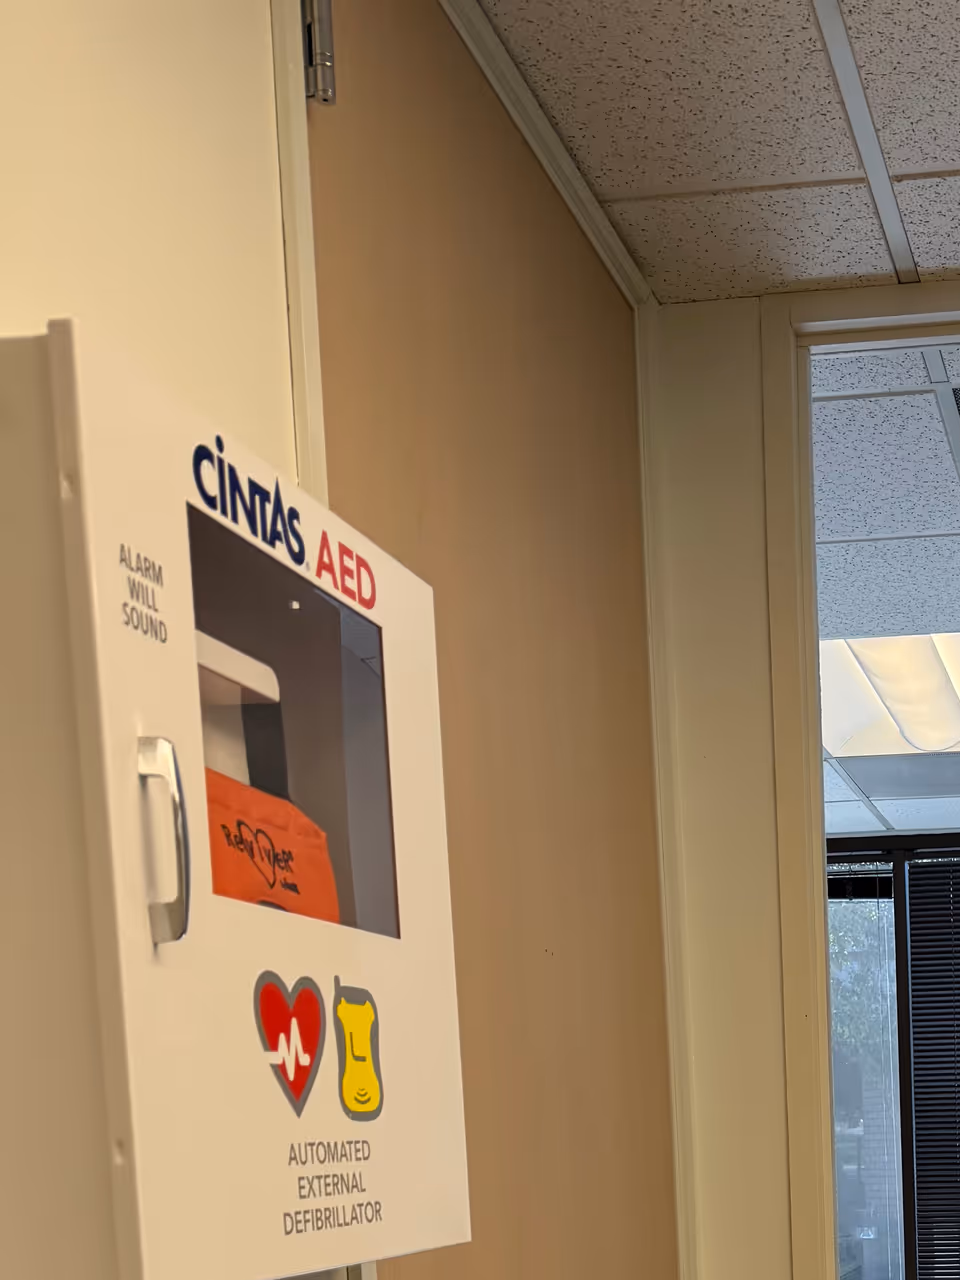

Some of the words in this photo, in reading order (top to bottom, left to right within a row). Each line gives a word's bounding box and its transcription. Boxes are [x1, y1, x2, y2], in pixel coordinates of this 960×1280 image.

[120, 543, 163, 588] ALARM
[315, 529, 376, 610] AED
[127, 574, 159, 613] WILL
[122, 601, 167, 643] SOUND
[288, 1140, 371, 1166] AUTOMATED
[297, 1171, 366, 1200] EXTERNAL
[282, 1201, 382, 1236] DEFIBRILLATOR
